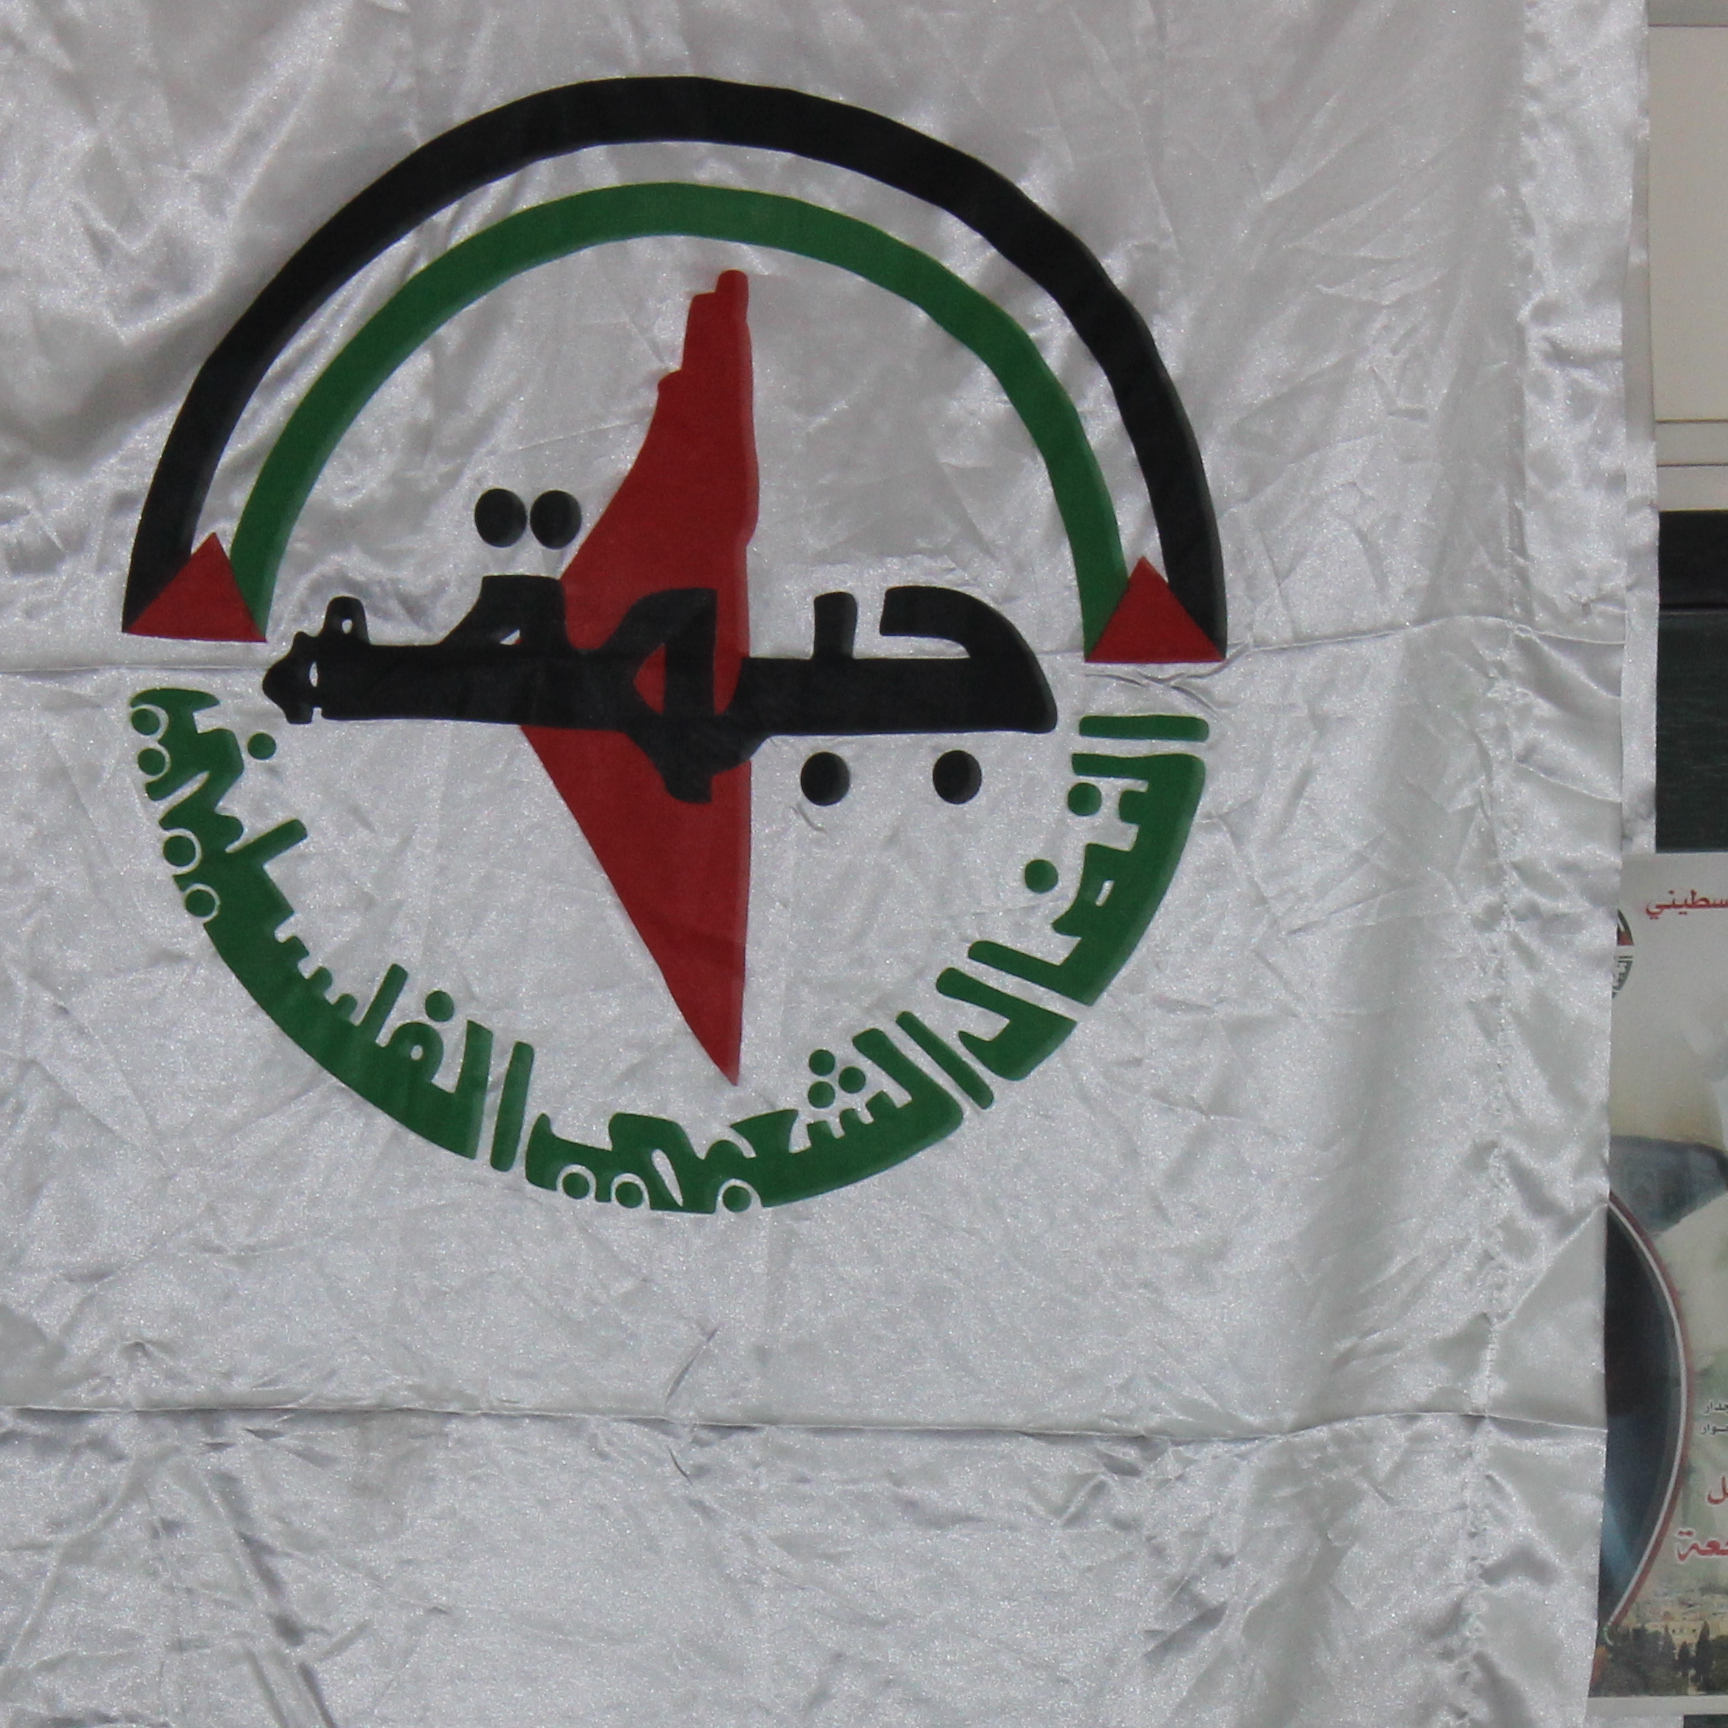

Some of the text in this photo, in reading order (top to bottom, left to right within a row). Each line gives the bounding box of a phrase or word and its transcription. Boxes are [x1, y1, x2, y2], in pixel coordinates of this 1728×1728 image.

[262, 487, 1058, 805] جبهة
[130, 687, 1210, 1216] النضال الشعبي الفلسطيني
